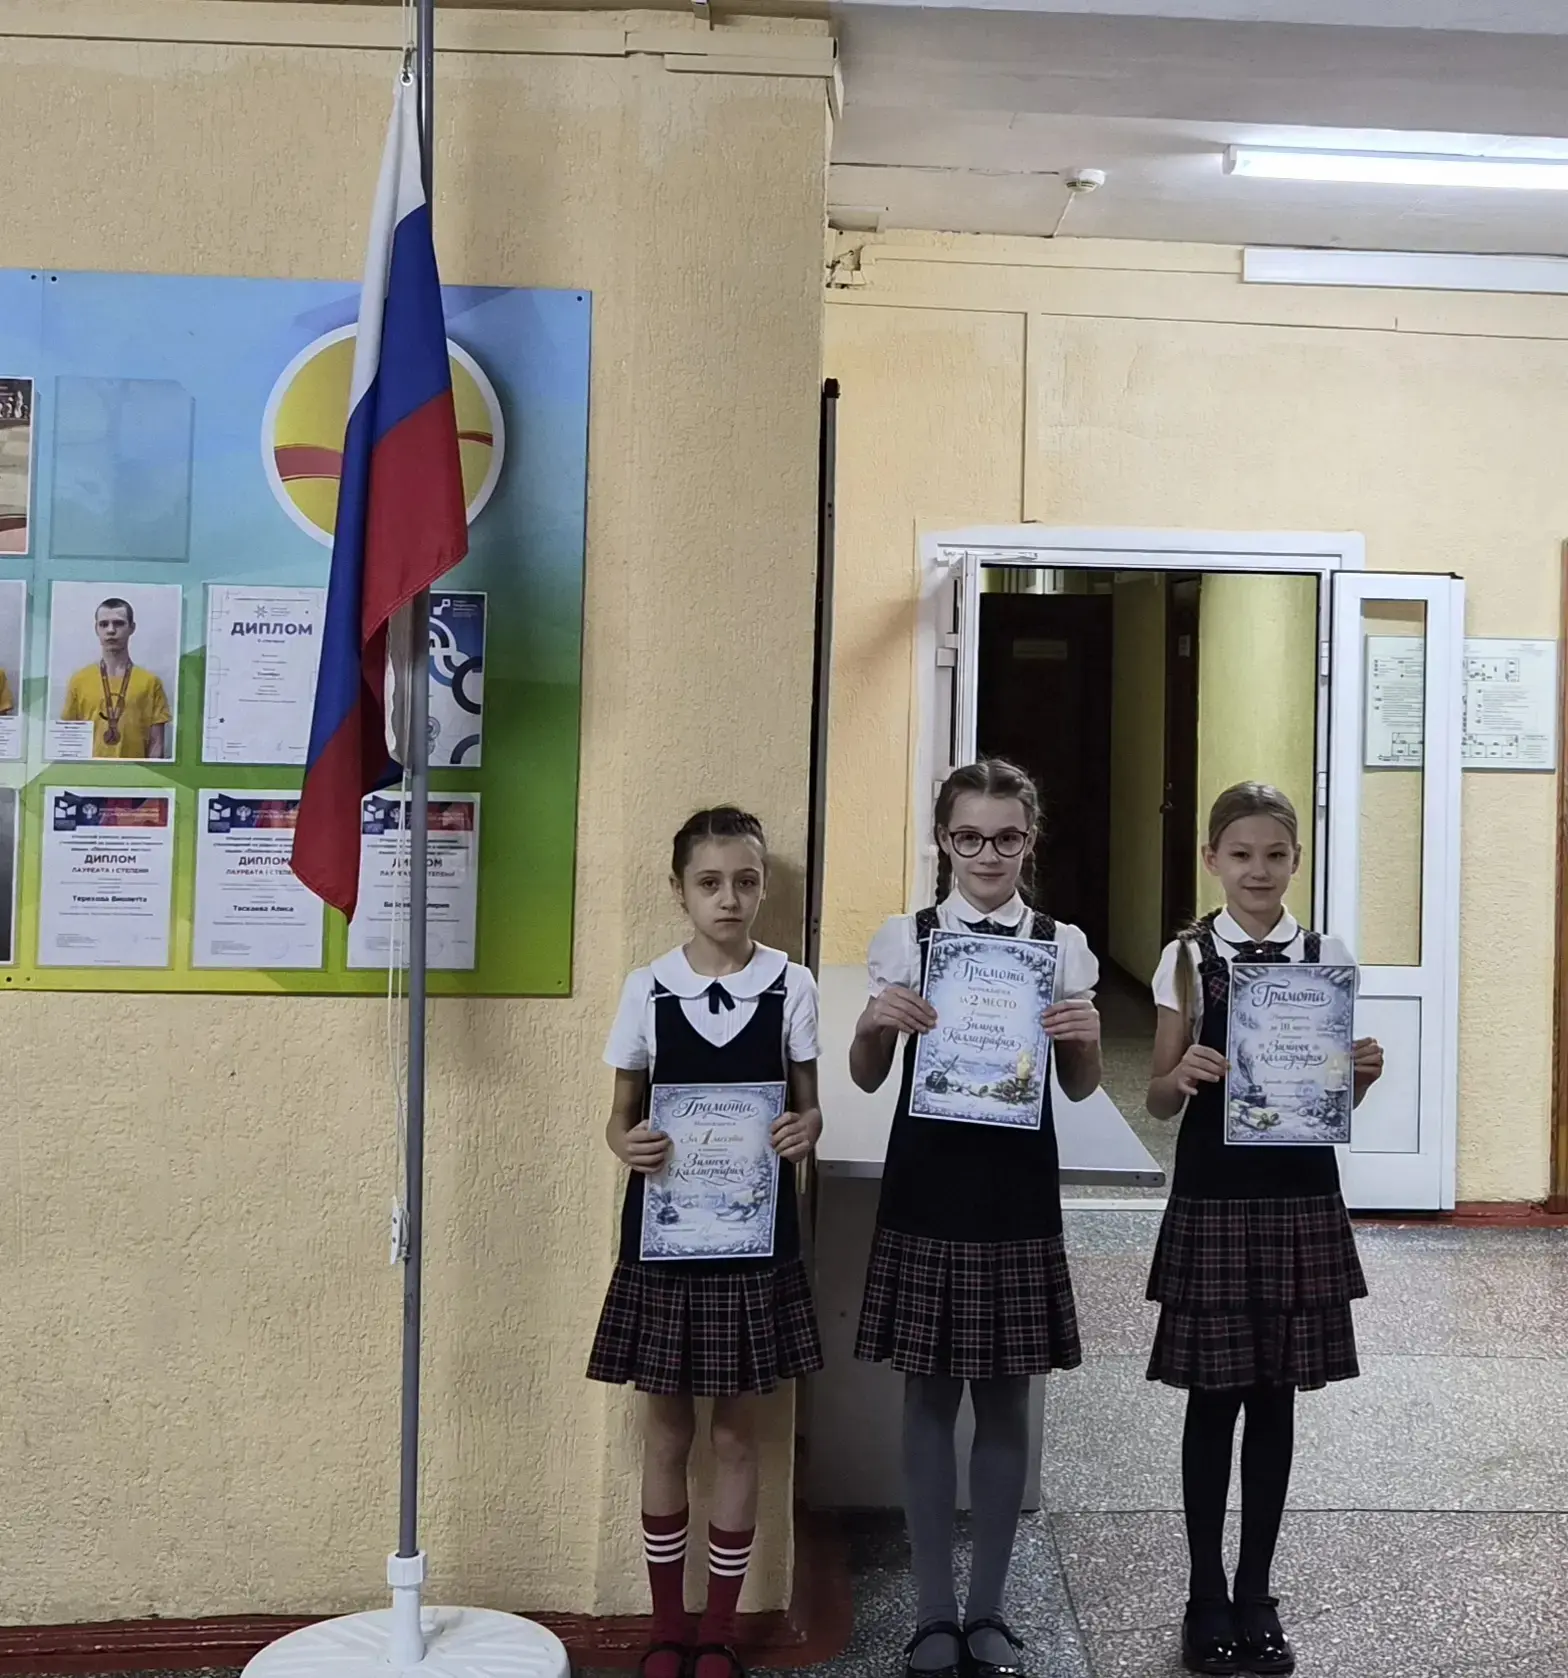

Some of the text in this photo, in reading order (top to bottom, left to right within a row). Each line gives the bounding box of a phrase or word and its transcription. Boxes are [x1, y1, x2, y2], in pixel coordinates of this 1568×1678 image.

[231, 621, 313, 636] ДИПЛОМ
[84, 854, 137, 864] ДИПЛОМ
[238, 856, 291, 866] ДИПЛОМ
[71, 866, 110, 874] ЛАУРЕАТА
[953, 957, 1030, 989] Грамота
[969, 994, 979, 1006] 2
[981, 996, 1018, 1009] МЕСТО
[1250, 979, 1333, 1010] Грамота
[672, 1095, 760, 1120] Грамота
[701, 1127, 715, 1146] 1
